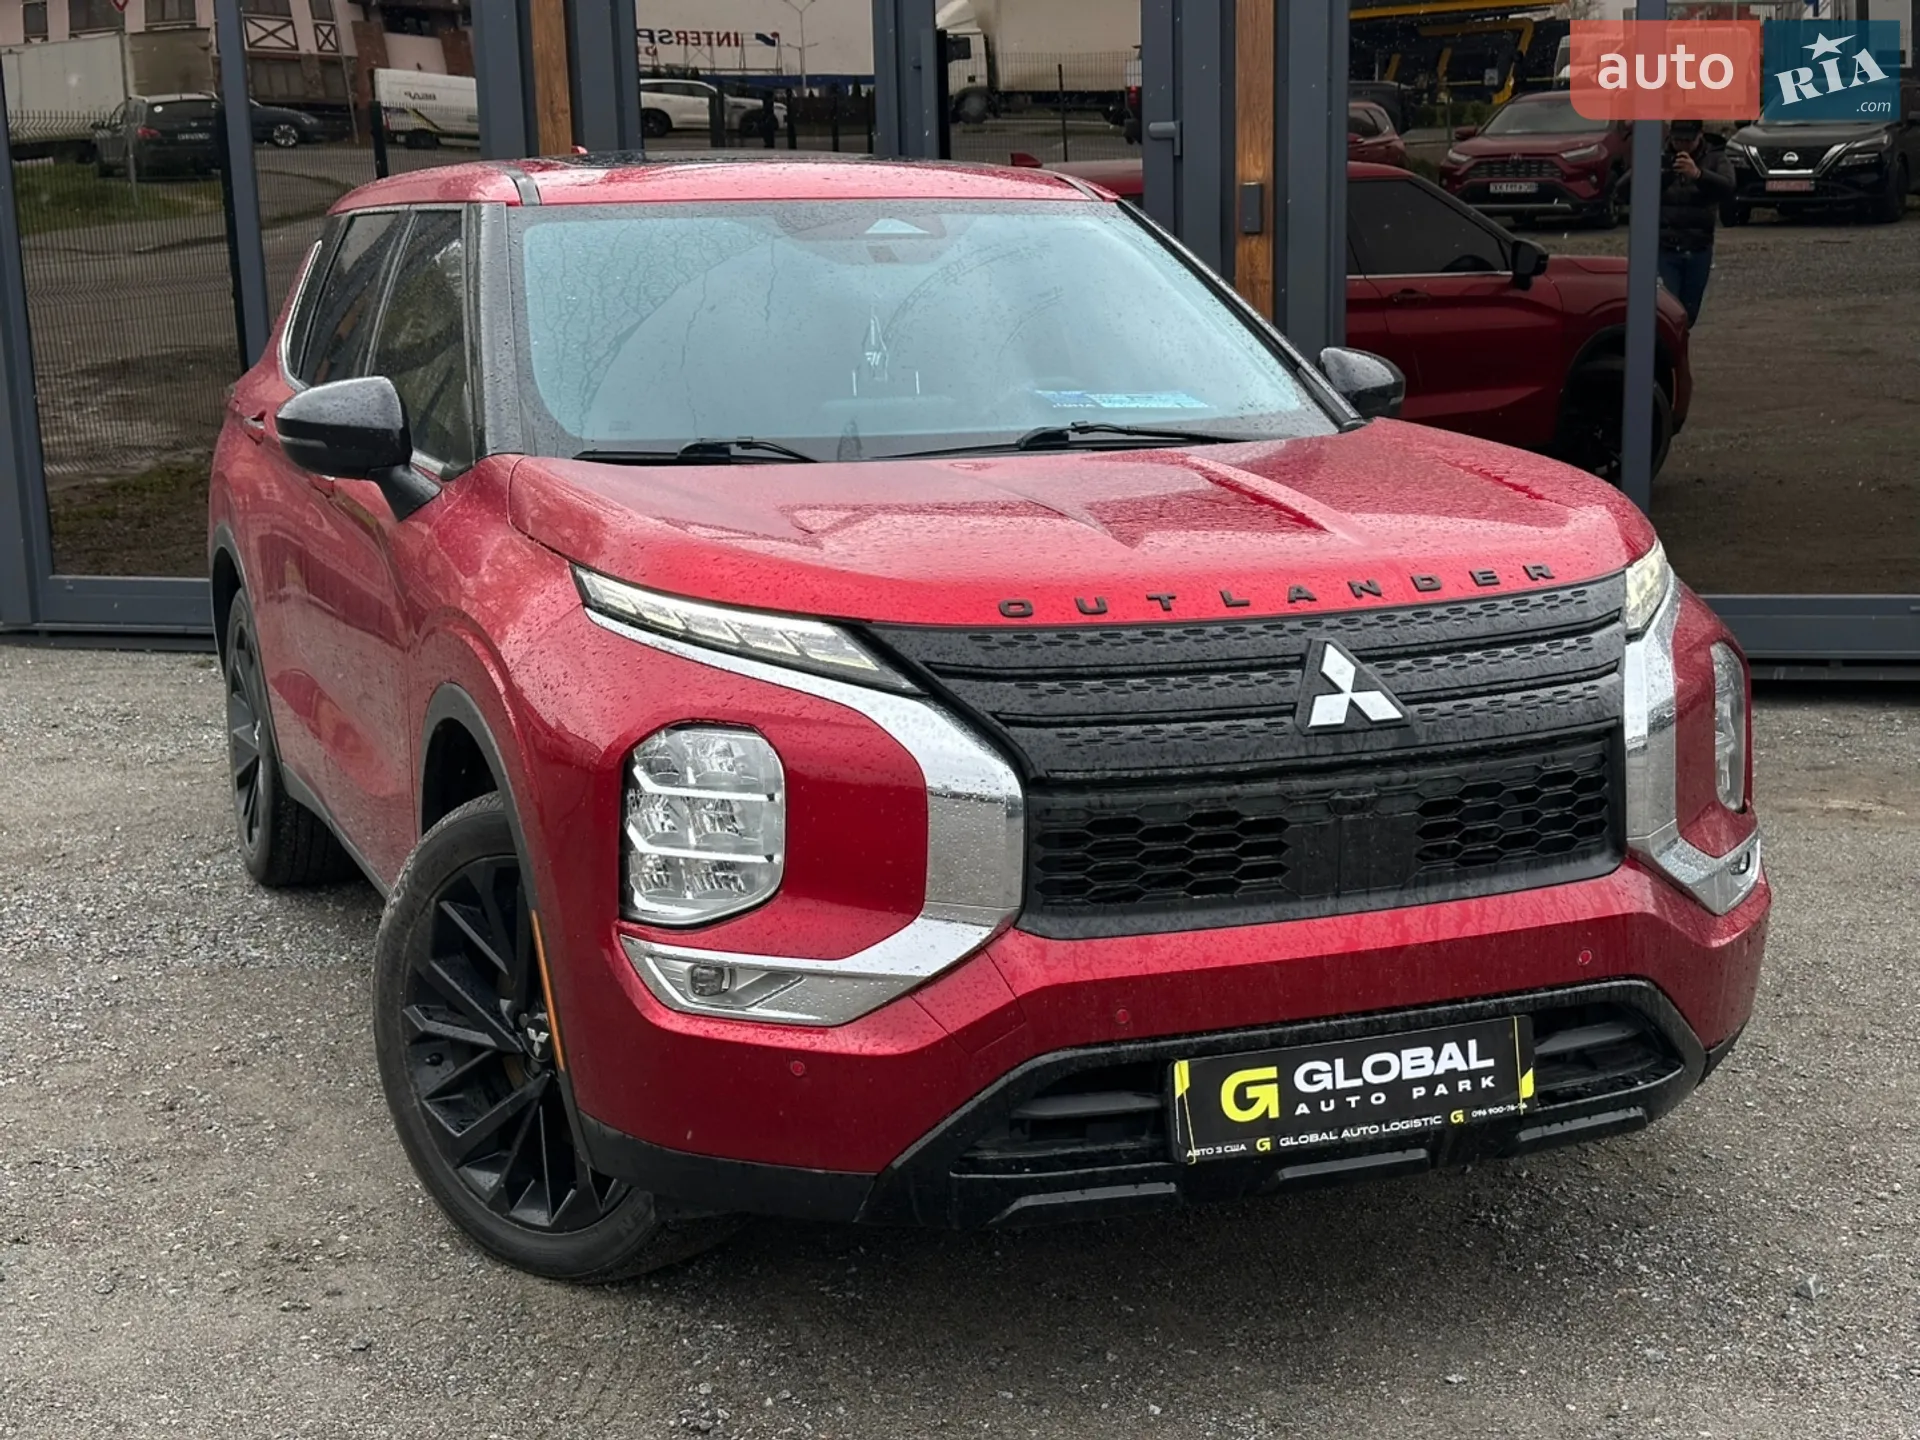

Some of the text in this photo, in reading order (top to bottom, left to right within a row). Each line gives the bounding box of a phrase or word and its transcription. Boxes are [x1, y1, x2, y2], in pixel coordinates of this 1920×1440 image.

[998, 563, 1555, 617] OUTLANDER
[1293, 1038, 1495, 1094] GLOBAL
[1294, 1075, 1495, 1116] AUTO PARK
[1279, 1115, 1443, 1147] GLOBAL AUTO LOGISTIC
